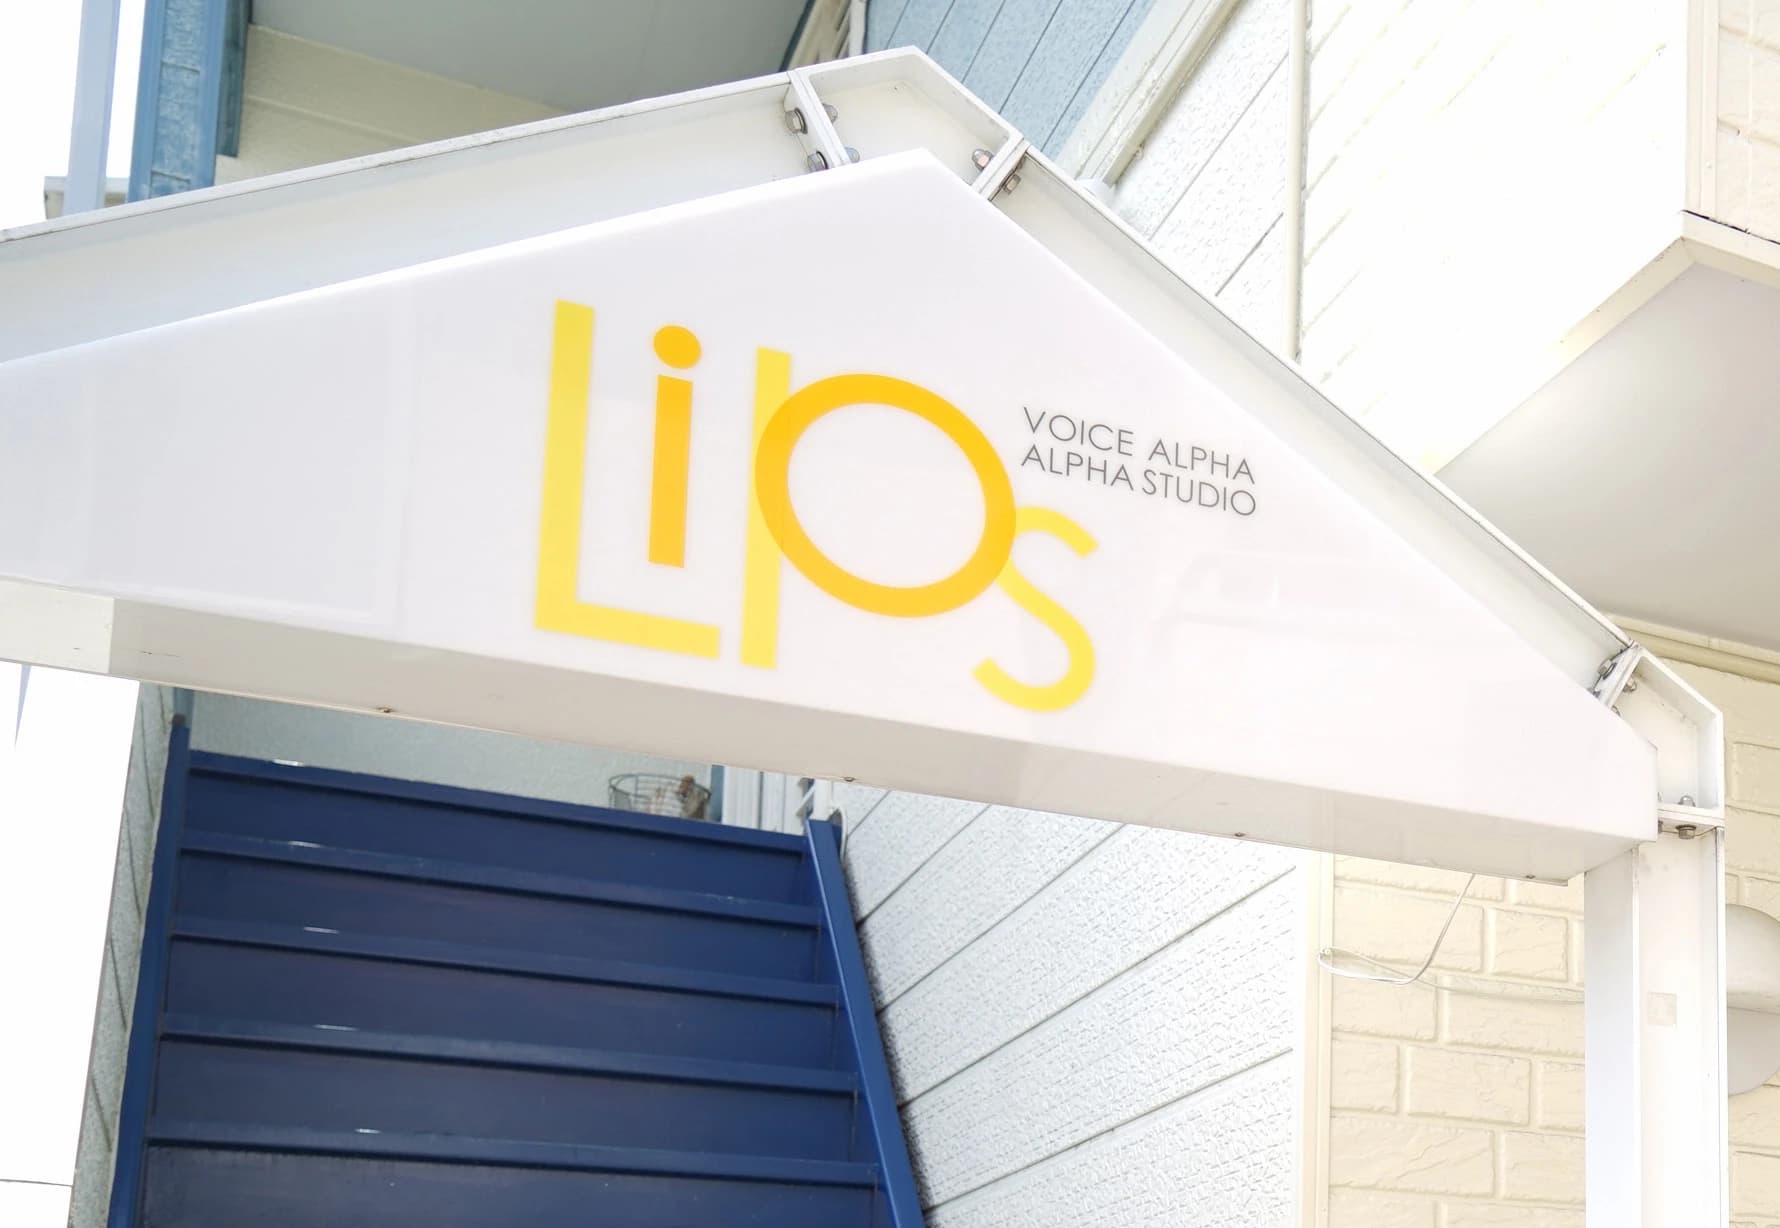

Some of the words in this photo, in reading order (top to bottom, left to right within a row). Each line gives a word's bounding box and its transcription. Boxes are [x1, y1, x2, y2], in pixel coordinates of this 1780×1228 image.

[1021, 445, 1134, 492] ALPHA
[1142, 470, 1257, 517] STUDIO
[1022, 406, 1134, 457] VOICE
[1148, 438, 1256, 485] ALPHA
[534, 299, 1097, 713] Lips
